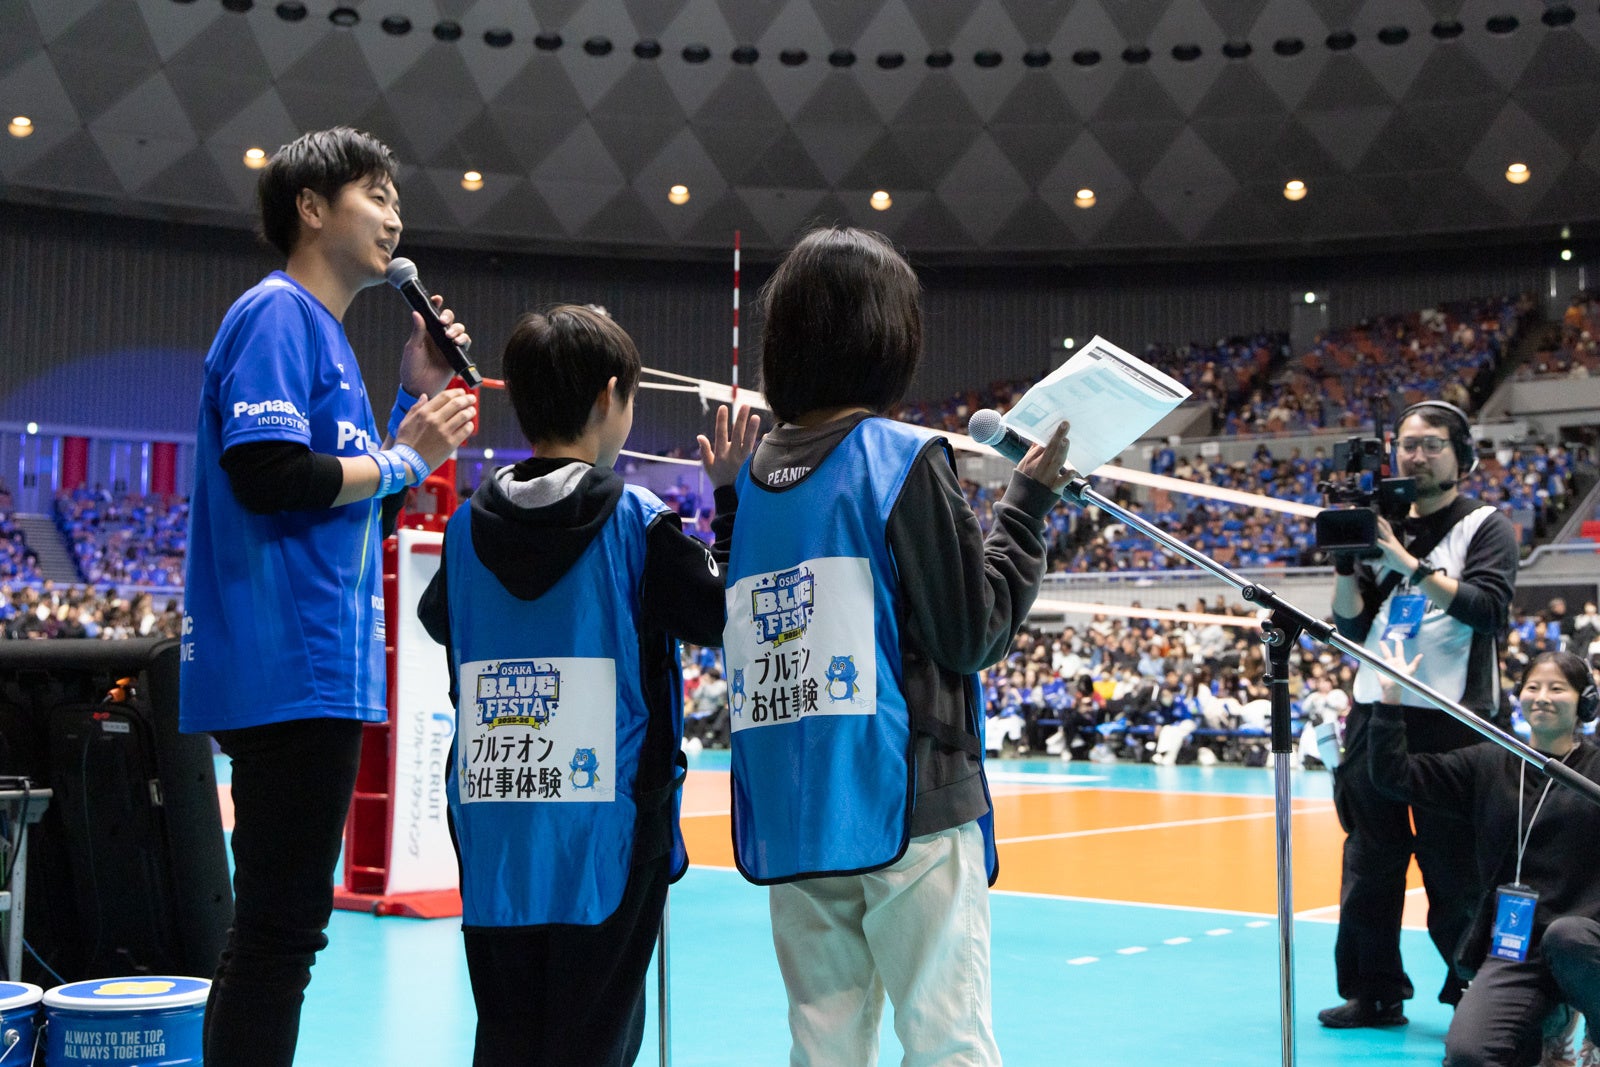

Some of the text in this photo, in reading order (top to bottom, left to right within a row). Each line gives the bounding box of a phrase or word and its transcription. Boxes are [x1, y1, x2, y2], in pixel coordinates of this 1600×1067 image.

[501, 665, 532, 676] OSAKA
[485, 697, 545, 718] FESTA
[472, 733, 554, 764] ブルテオン
[428, 732, 443, 824] RECRUIT
[467, 766, 562, 799] お仕事体験
[65, 1029, 165, 1045] ALWAYS TO THE TOP.
[64, 1043, 166, 1060] ALL WAYS TOGETHER
